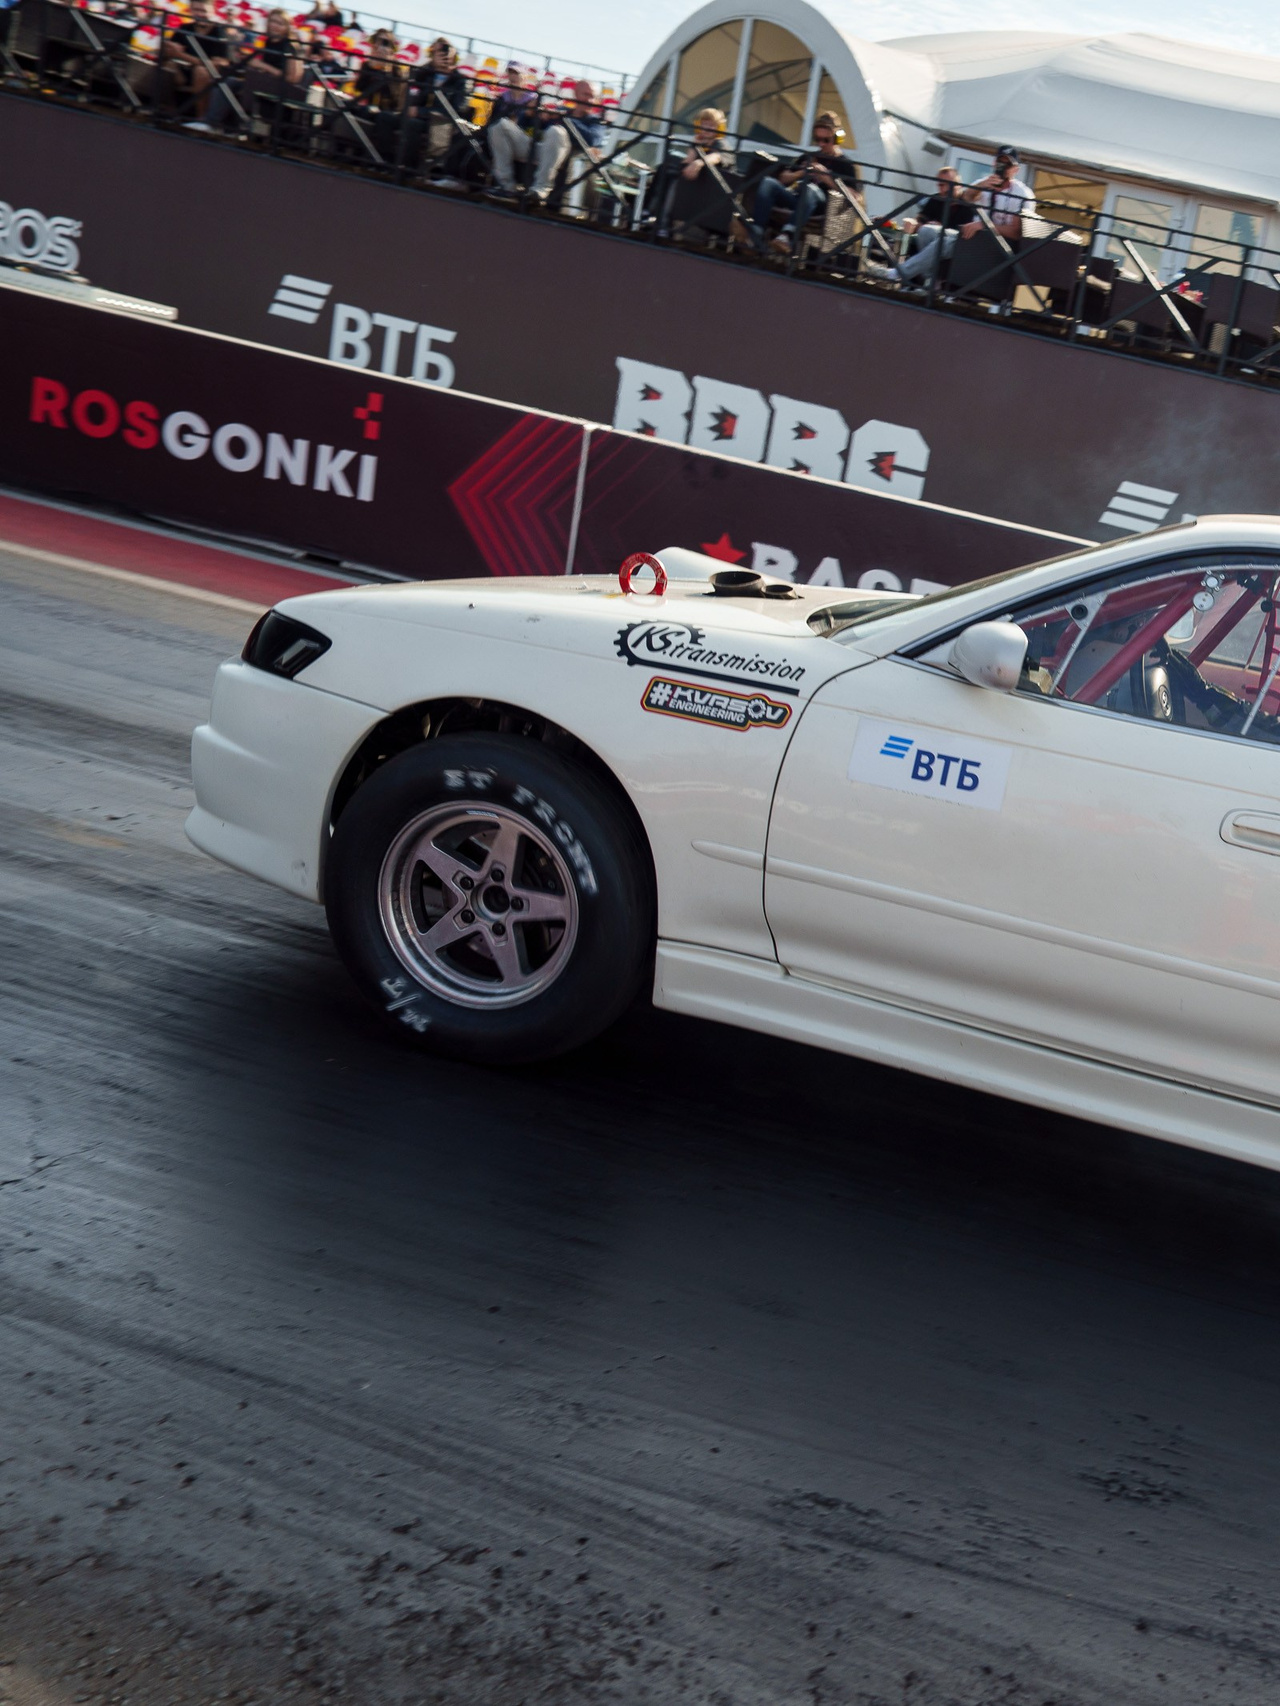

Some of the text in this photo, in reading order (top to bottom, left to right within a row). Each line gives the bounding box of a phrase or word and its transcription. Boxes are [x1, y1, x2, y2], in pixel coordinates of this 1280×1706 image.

[329, 303, 458, 389] ВТБ
[29, 376, 378, 502] ROSGONKI
[612, 356, 931, 501] RDRC
[751, 541, 952, 595] RAC
[669, 699, 746, 724] ENGINEERING
[911, 748, 982, 792] ВТБ
